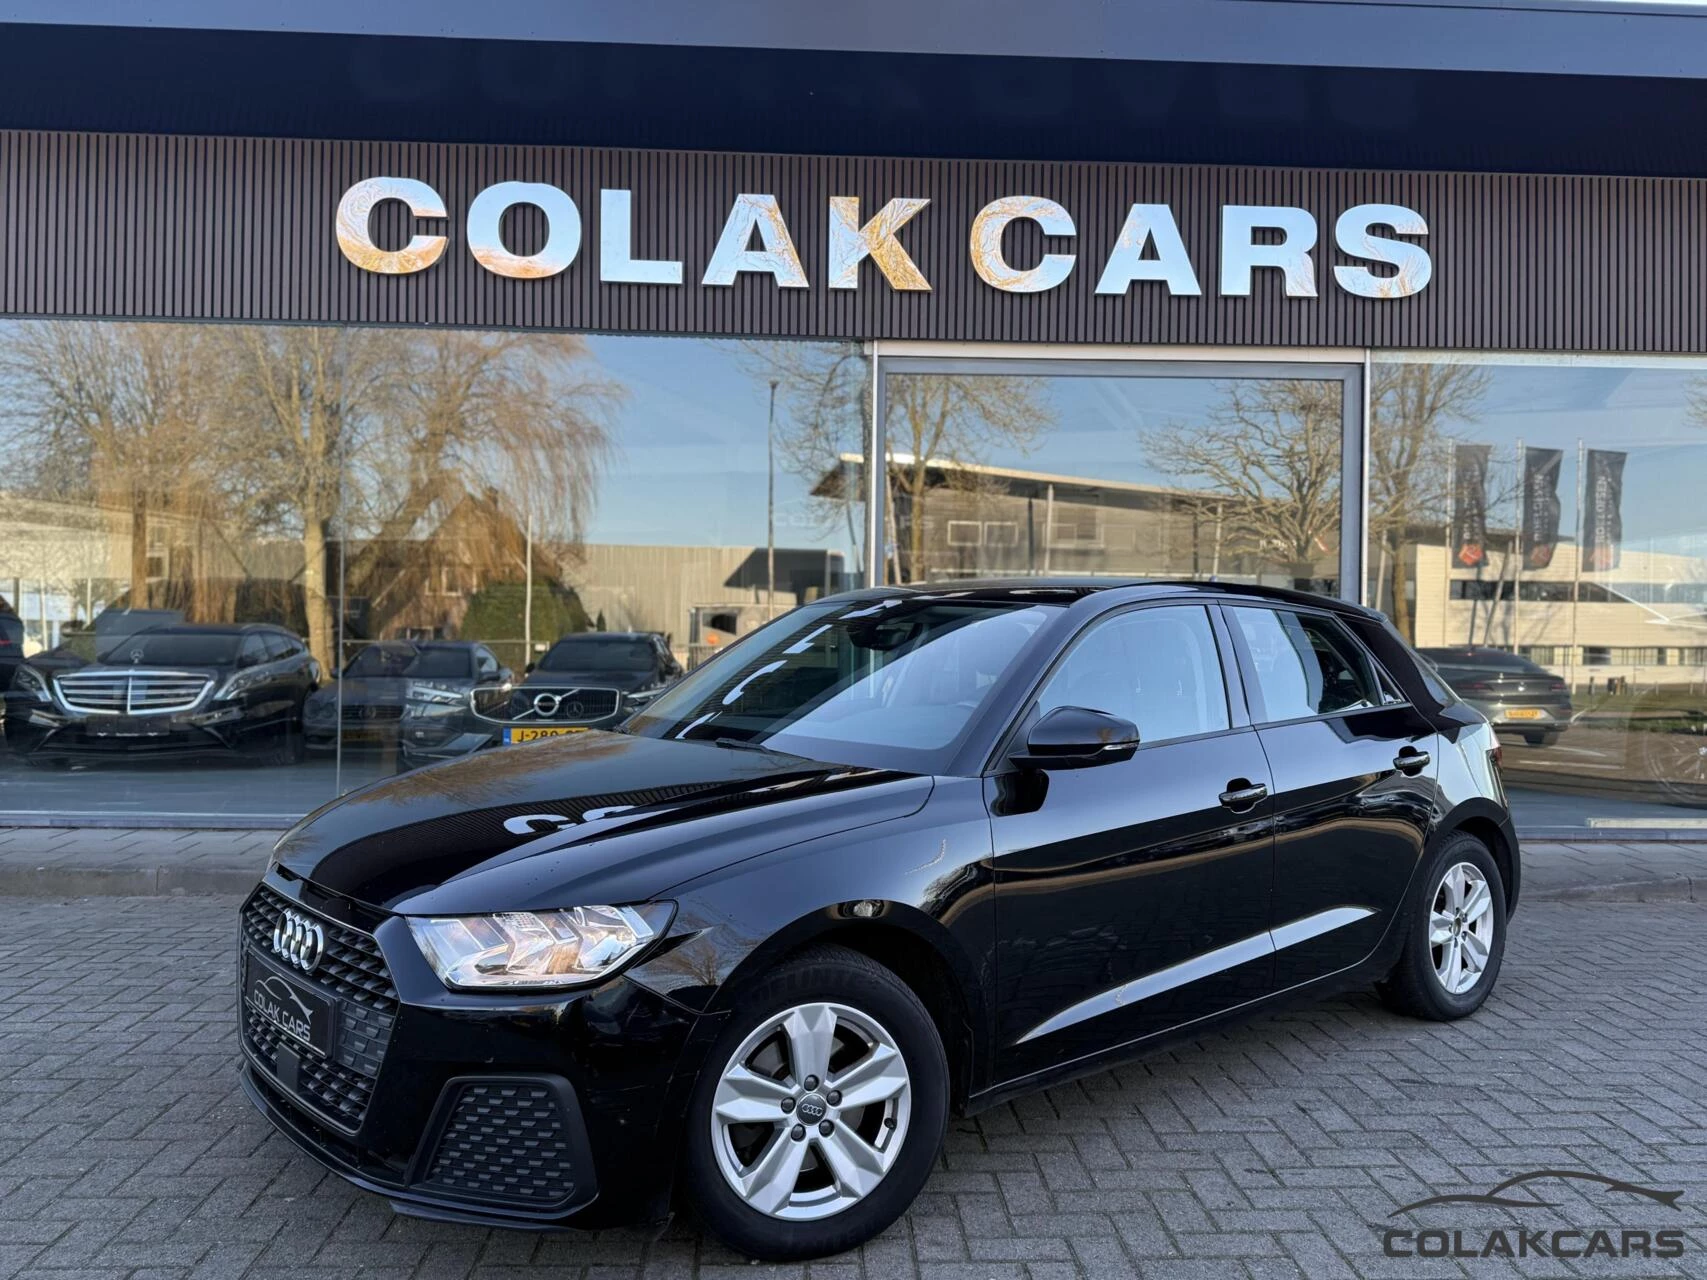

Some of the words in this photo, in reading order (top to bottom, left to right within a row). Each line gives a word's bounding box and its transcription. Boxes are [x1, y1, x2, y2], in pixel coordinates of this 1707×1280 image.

[335, 176, 931, 291] COLAK
[970, 195, 1433, 299] CARS
[253, 989, 280, 1022] COLAK
[282, 1010, 311, 1041] CARS
